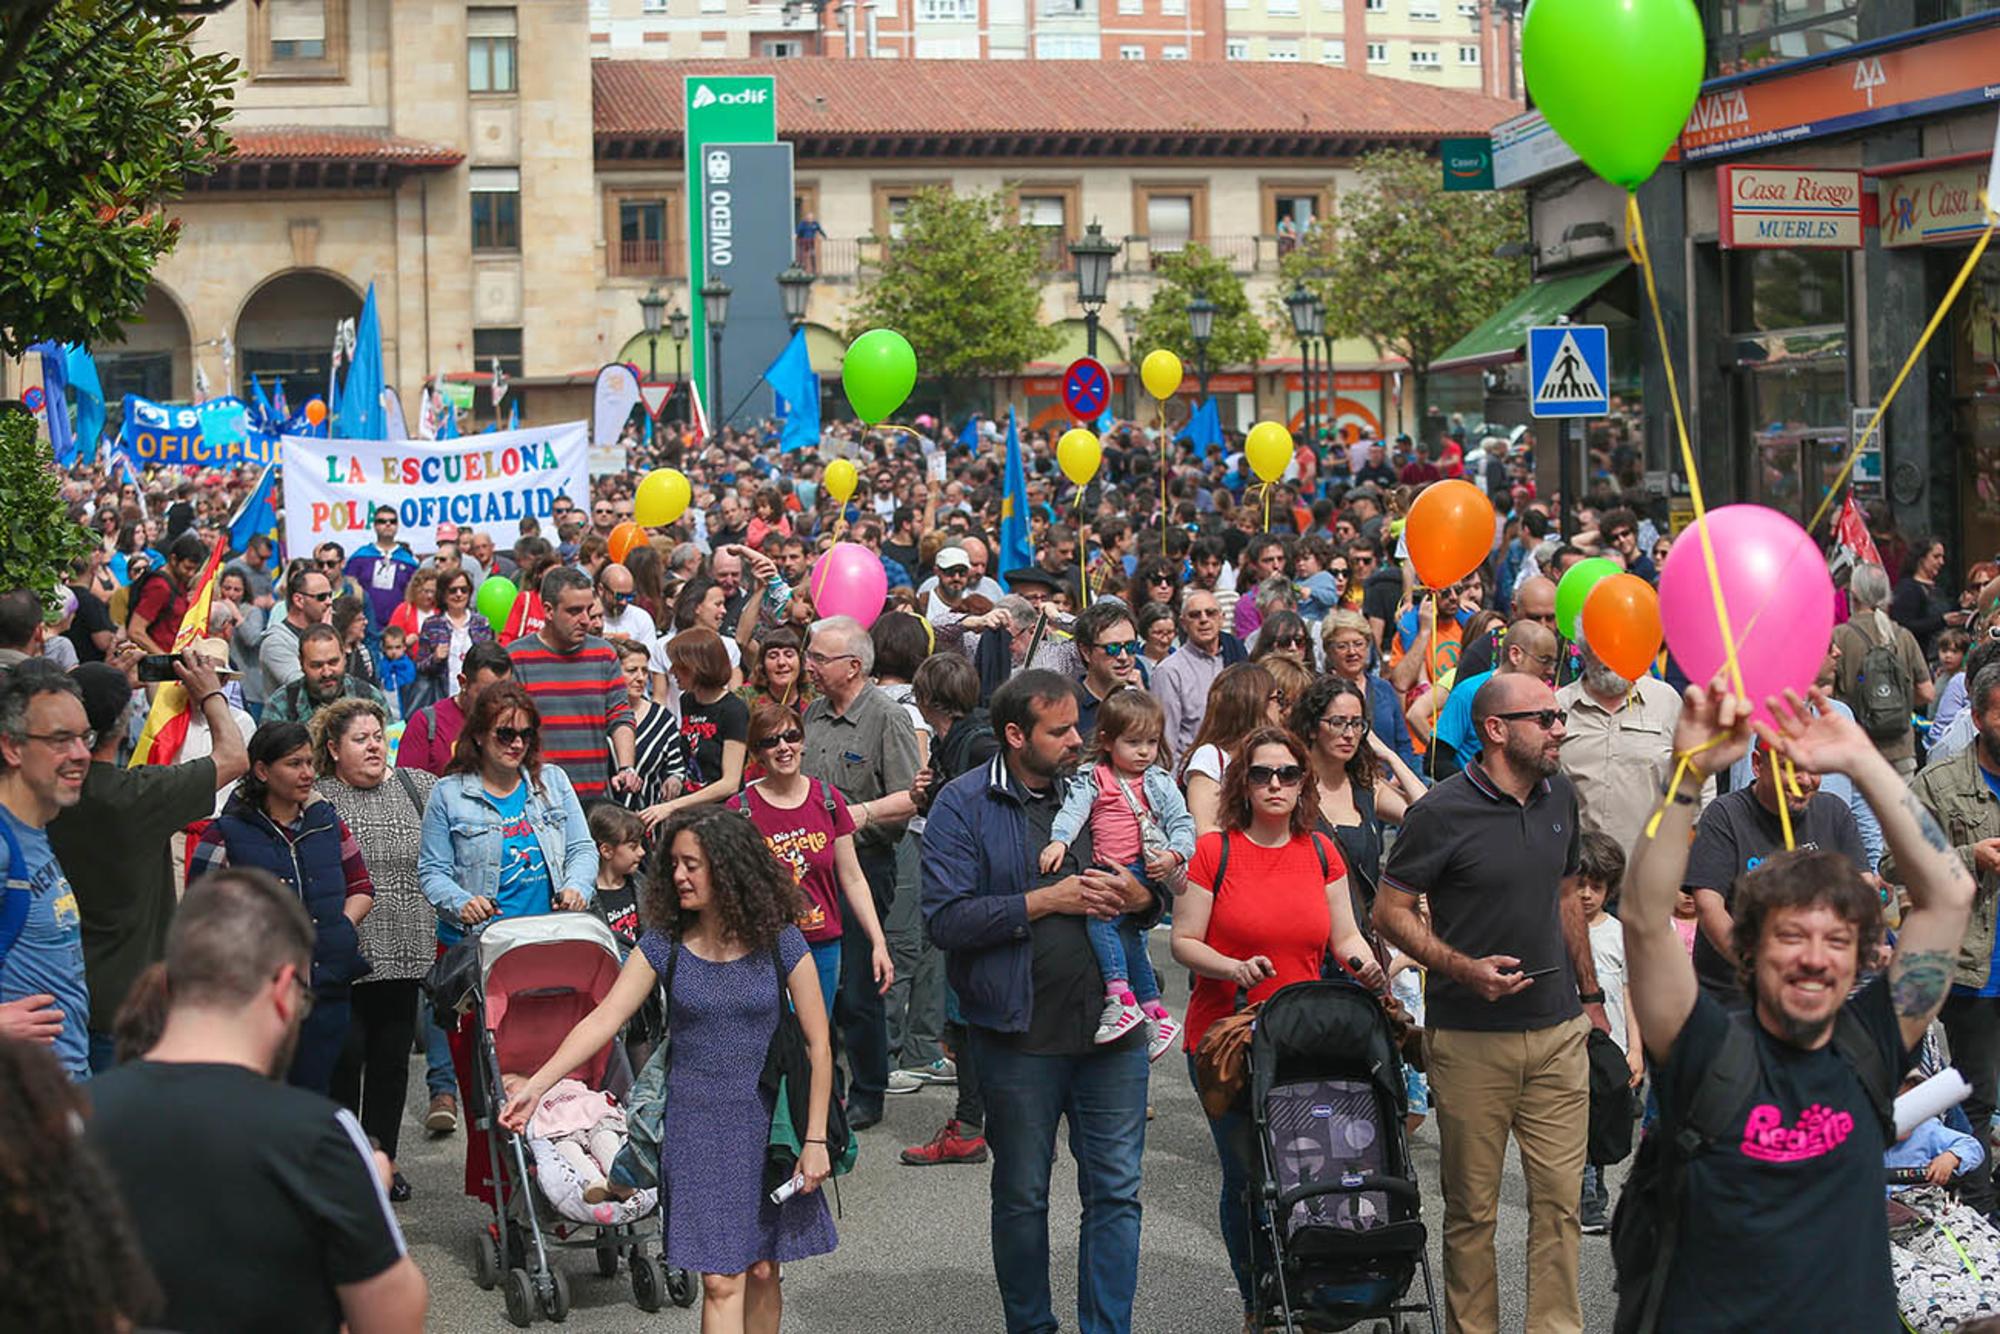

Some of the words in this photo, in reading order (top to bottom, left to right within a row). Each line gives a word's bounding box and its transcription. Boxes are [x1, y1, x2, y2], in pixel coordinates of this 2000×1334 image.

[718, 88, 768, 105] adif
[1738, 175, 1786, 200] Casa
[1794, 176, 1854, 207] Riesgo
[1928, 181, 1969, 218] Casa
[710, 190, 733, 266] OVIEDO
[1757, 220, 1839, 239] MUEBLES
[326, 455, 367, 484] LA
[382, 441, 559, 486] ESCUELONA
